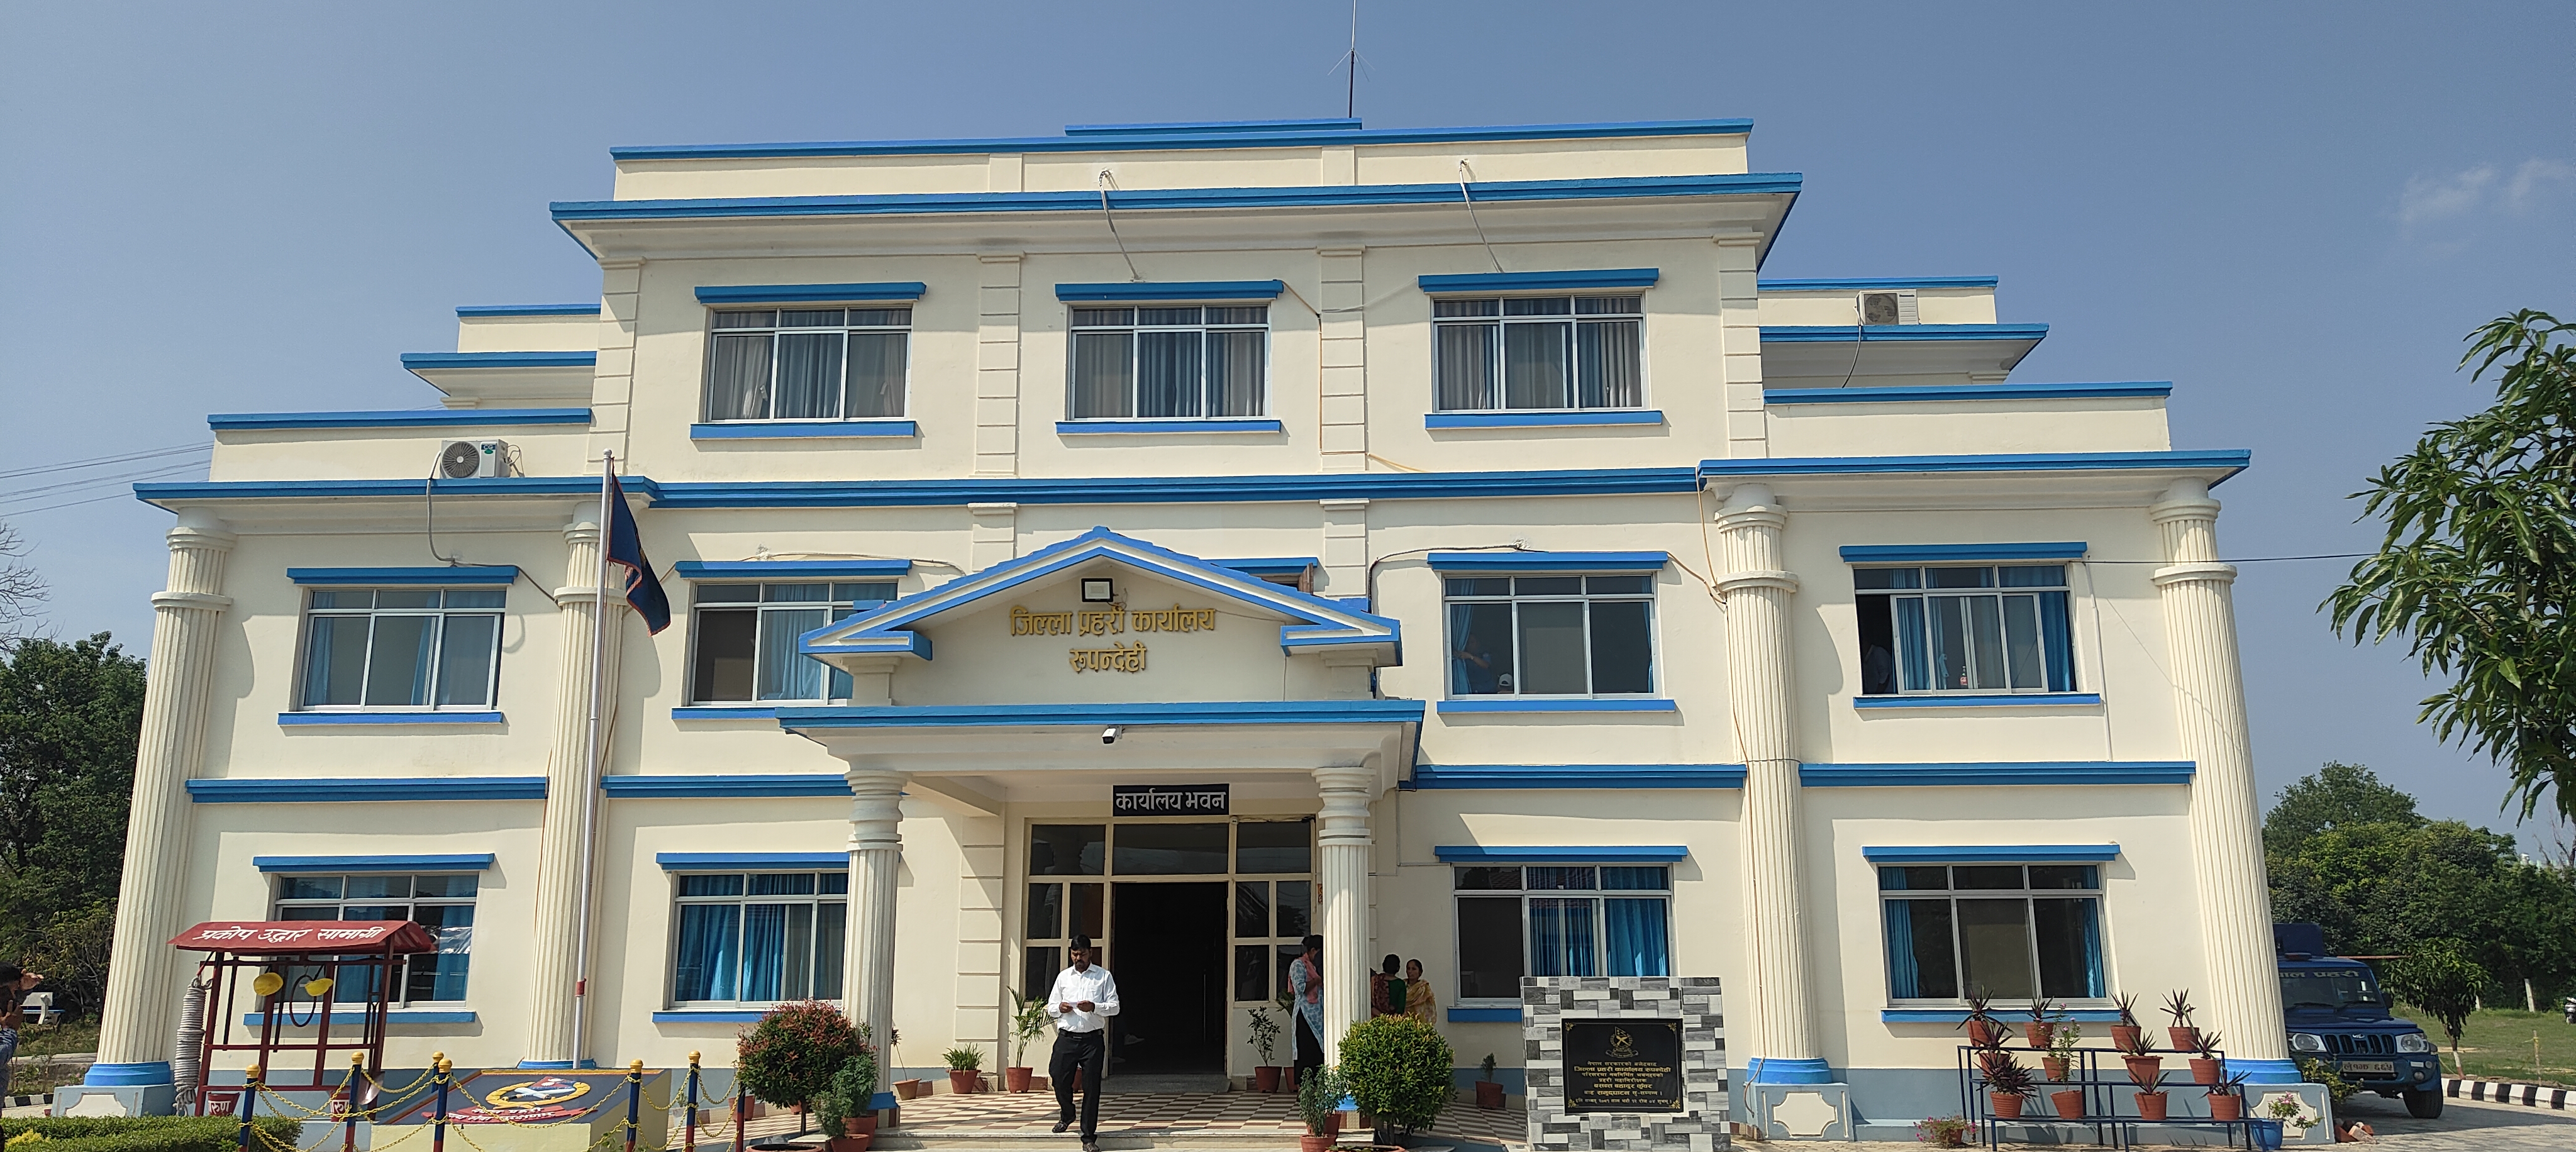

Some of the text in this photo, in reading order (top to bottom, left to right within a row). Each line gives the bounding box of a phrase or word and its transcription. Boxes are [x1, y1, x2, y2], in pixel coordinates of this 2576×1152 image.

[1009, 603, 1216, 636] जिल्ला प्रहरी कार्यालय
[1116, 788, 1226, 810] कार्यालय भवन
[192, 926, 258, 941] प्रकोप
[258, 928, 313, 943] उद्धार
